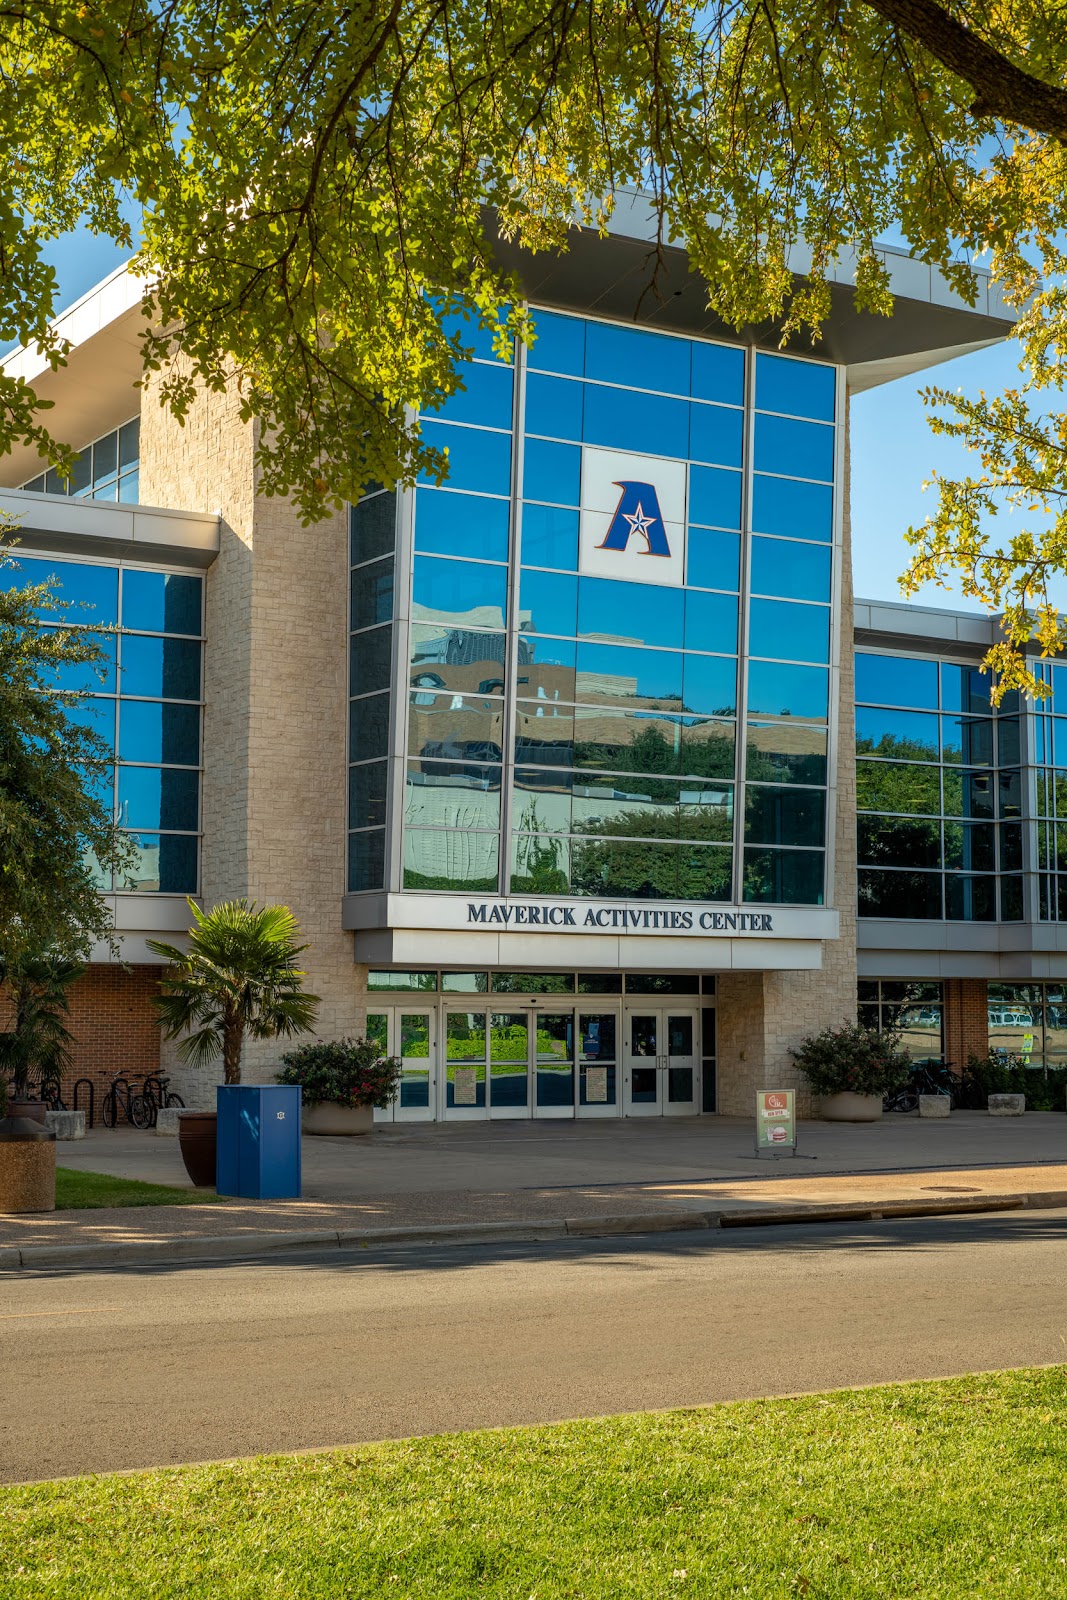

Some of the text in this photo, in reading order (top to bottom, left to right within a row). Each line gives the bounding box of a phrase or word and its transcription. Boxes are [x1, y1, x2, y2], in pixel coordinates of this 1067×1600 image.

[466, 903, 774, 932] MAVERICK ACTIVITIES CENTER
